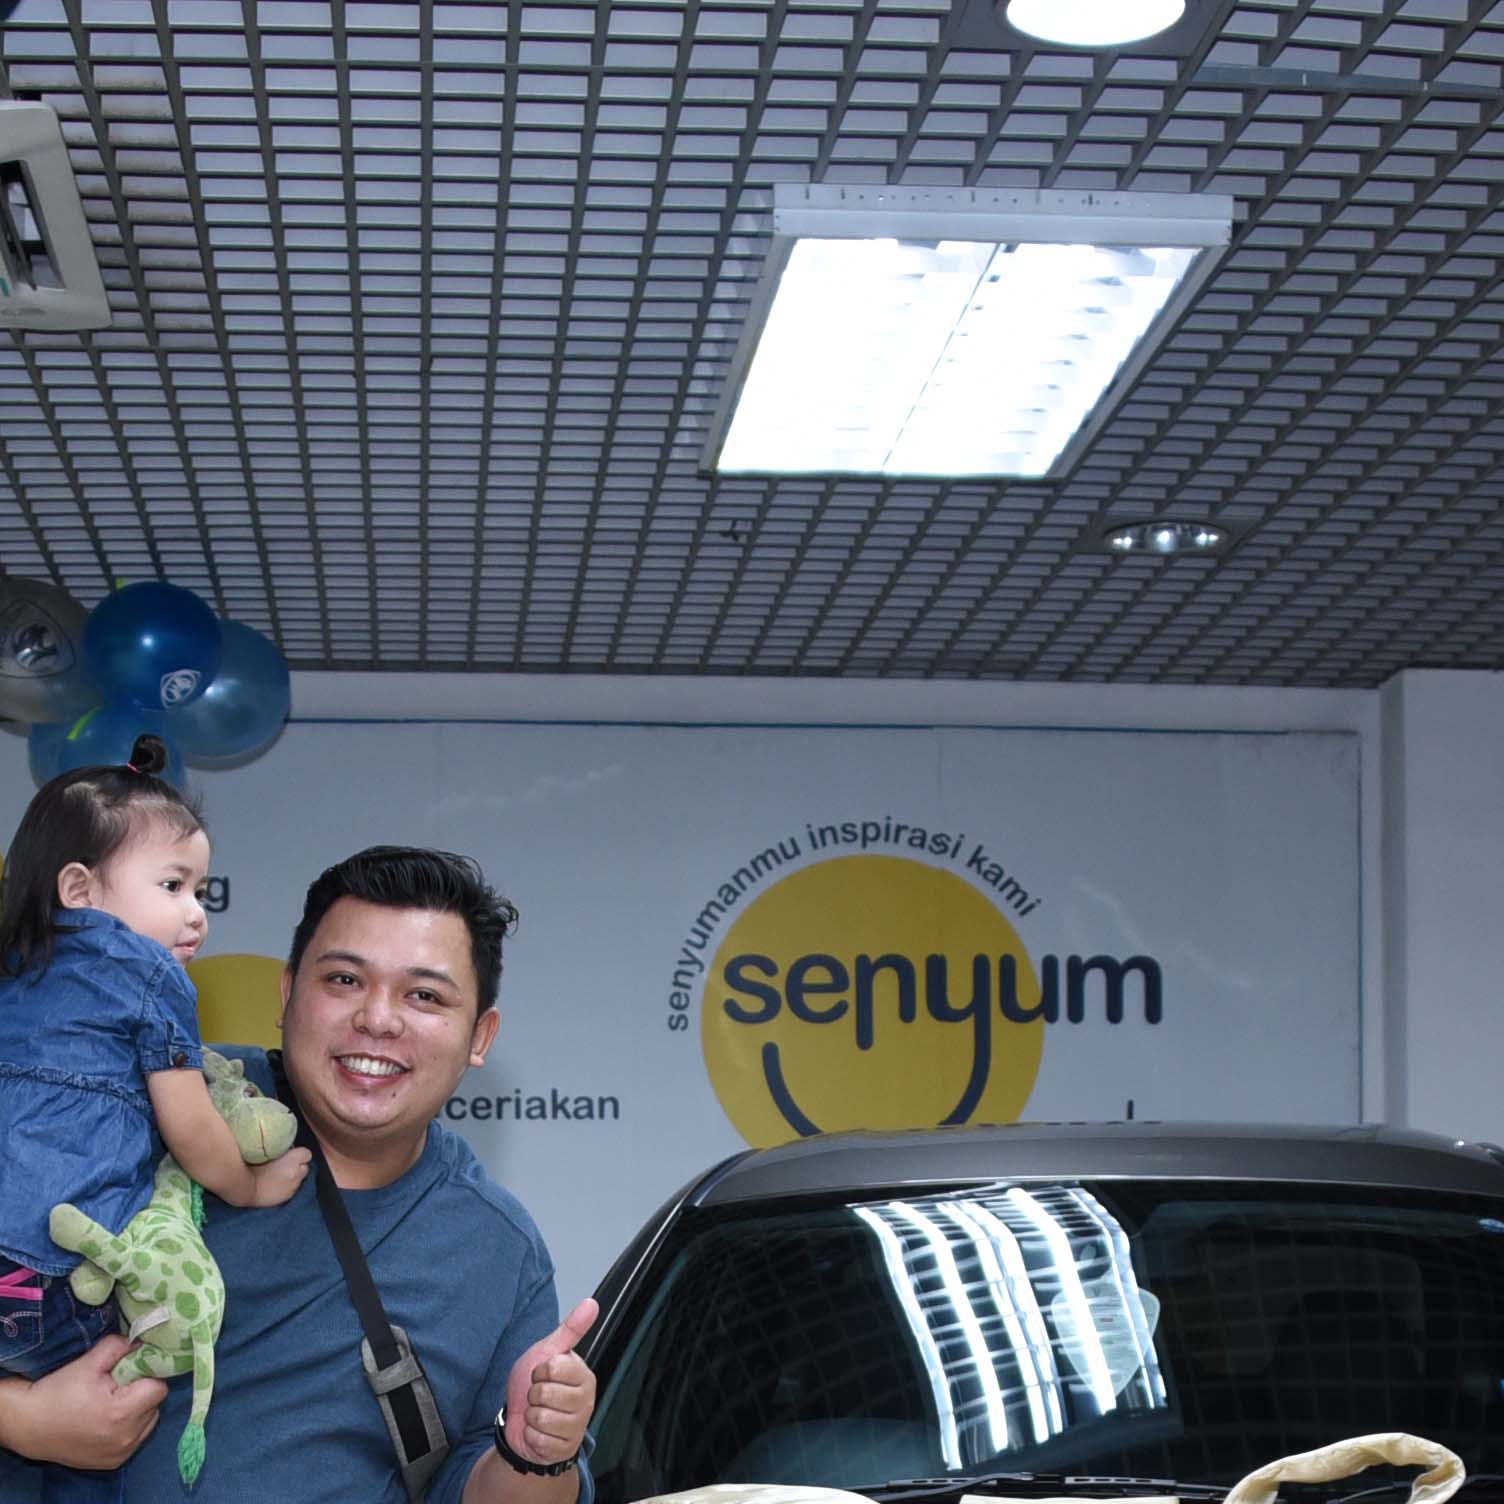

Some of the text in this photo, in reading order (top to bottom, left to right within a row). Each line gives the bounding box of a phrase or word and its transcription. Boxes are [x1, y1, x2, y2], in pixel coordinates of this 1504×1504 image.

[667, 816, 1042, 1032] senyumanmu inspirasi kami
[436, 1088, 620, 1120] ceriakan
[722, 952, 1164, 1126] senyum
